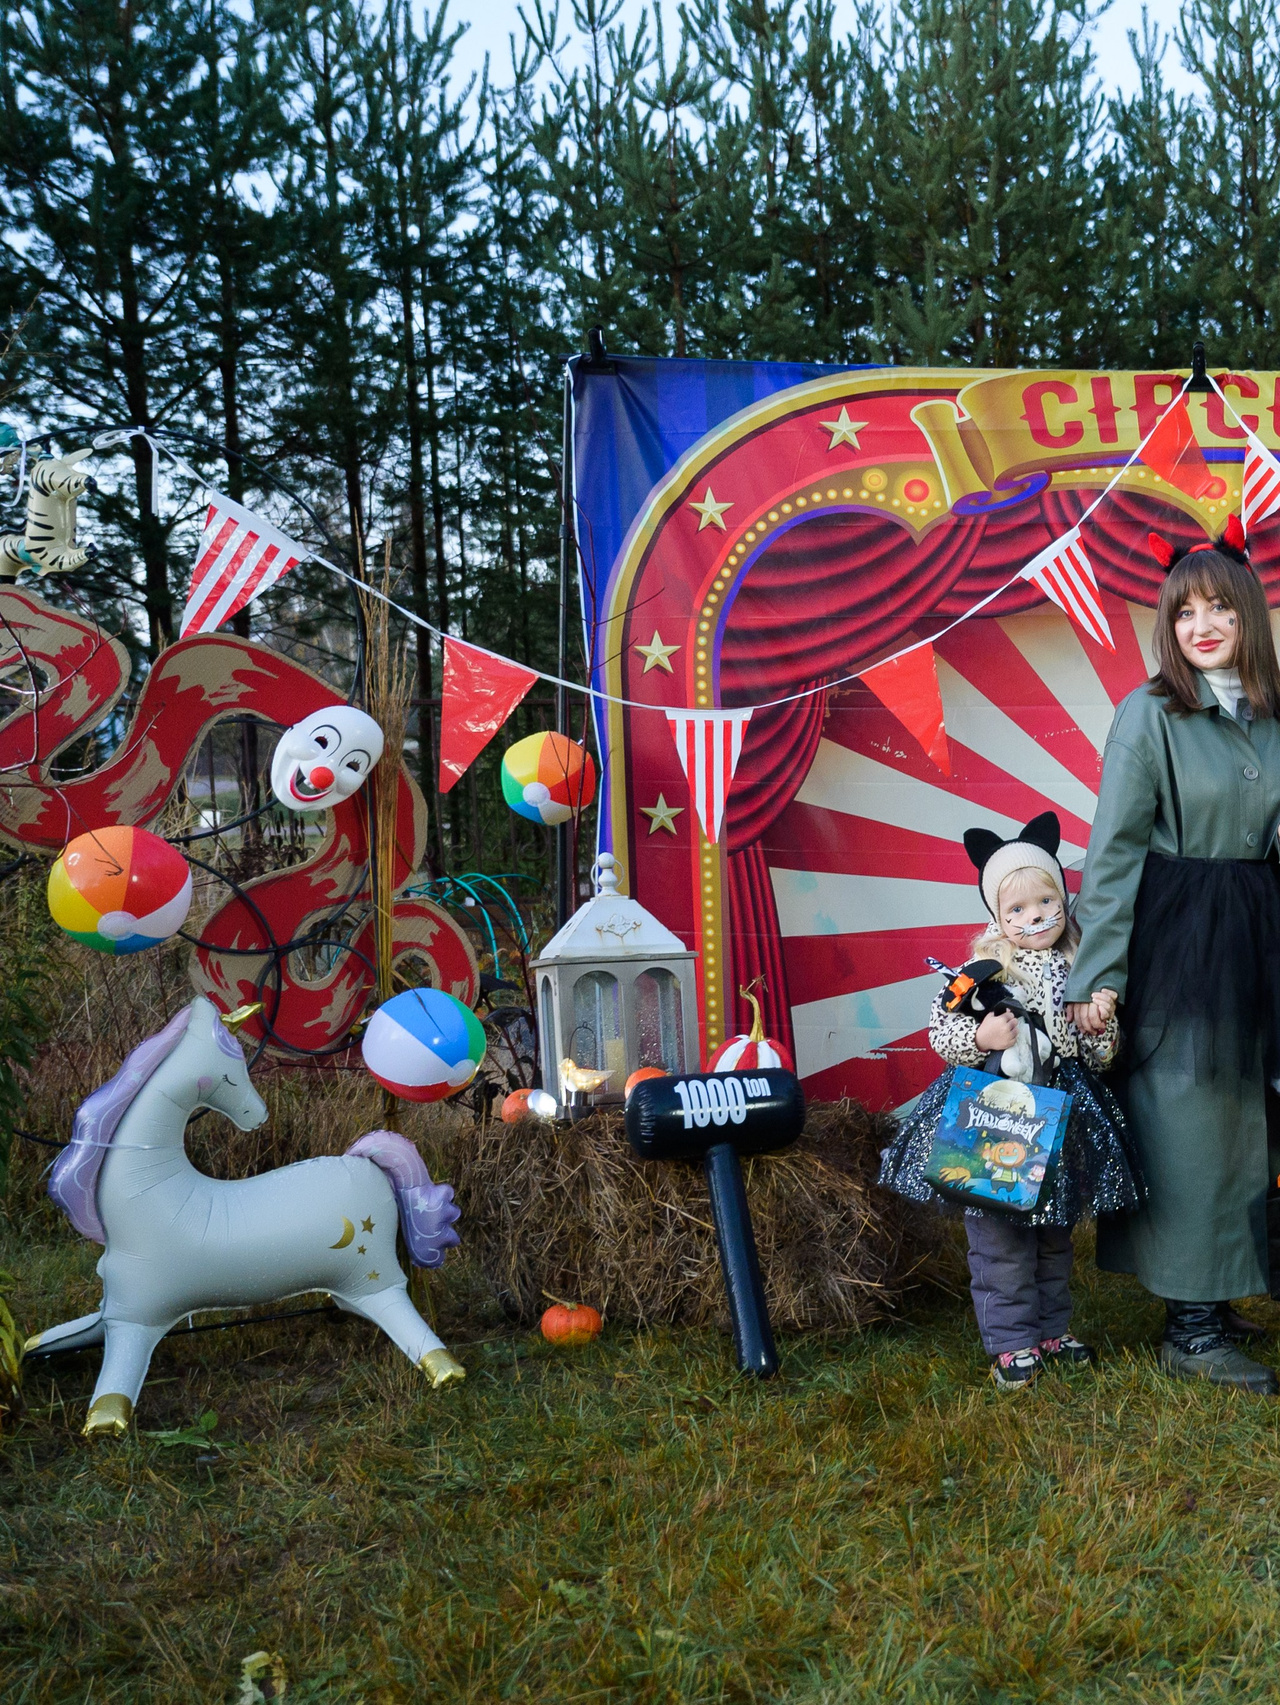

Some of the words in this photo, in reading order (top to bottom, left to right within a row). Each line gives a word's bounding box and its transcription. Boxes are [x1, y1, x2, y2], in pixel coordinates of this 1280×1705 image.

[674, 1077, 747, 1129] 1000
[743, 1077, 771, 1098] ton
[965, 1102, 1045, 1145] HALLOWEEN
